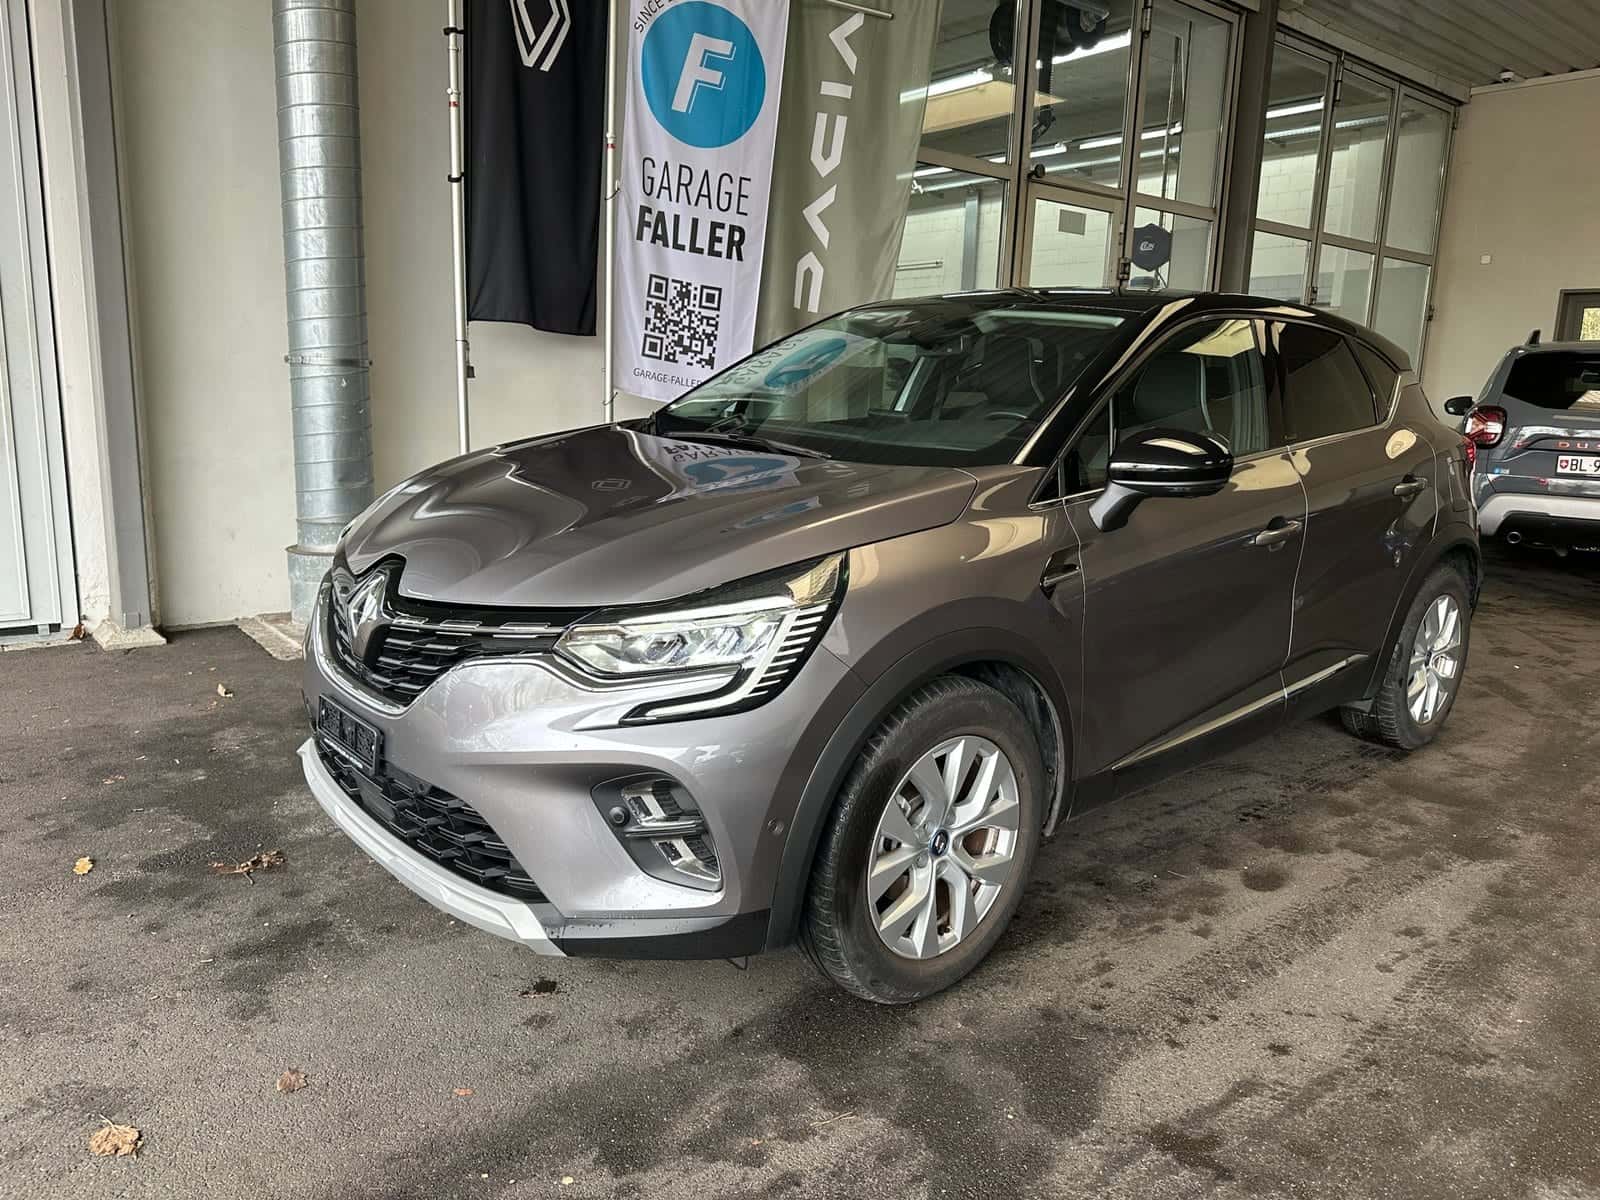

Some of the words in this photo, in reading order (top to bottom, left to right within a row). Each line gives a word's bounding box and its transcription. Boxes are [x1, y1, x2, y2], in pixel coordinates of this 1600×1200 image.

[634, 0, 665, 33] SINCE
[641, 156, 752, 216] GARAGE
[635, 205, 746, 262] FALLER
